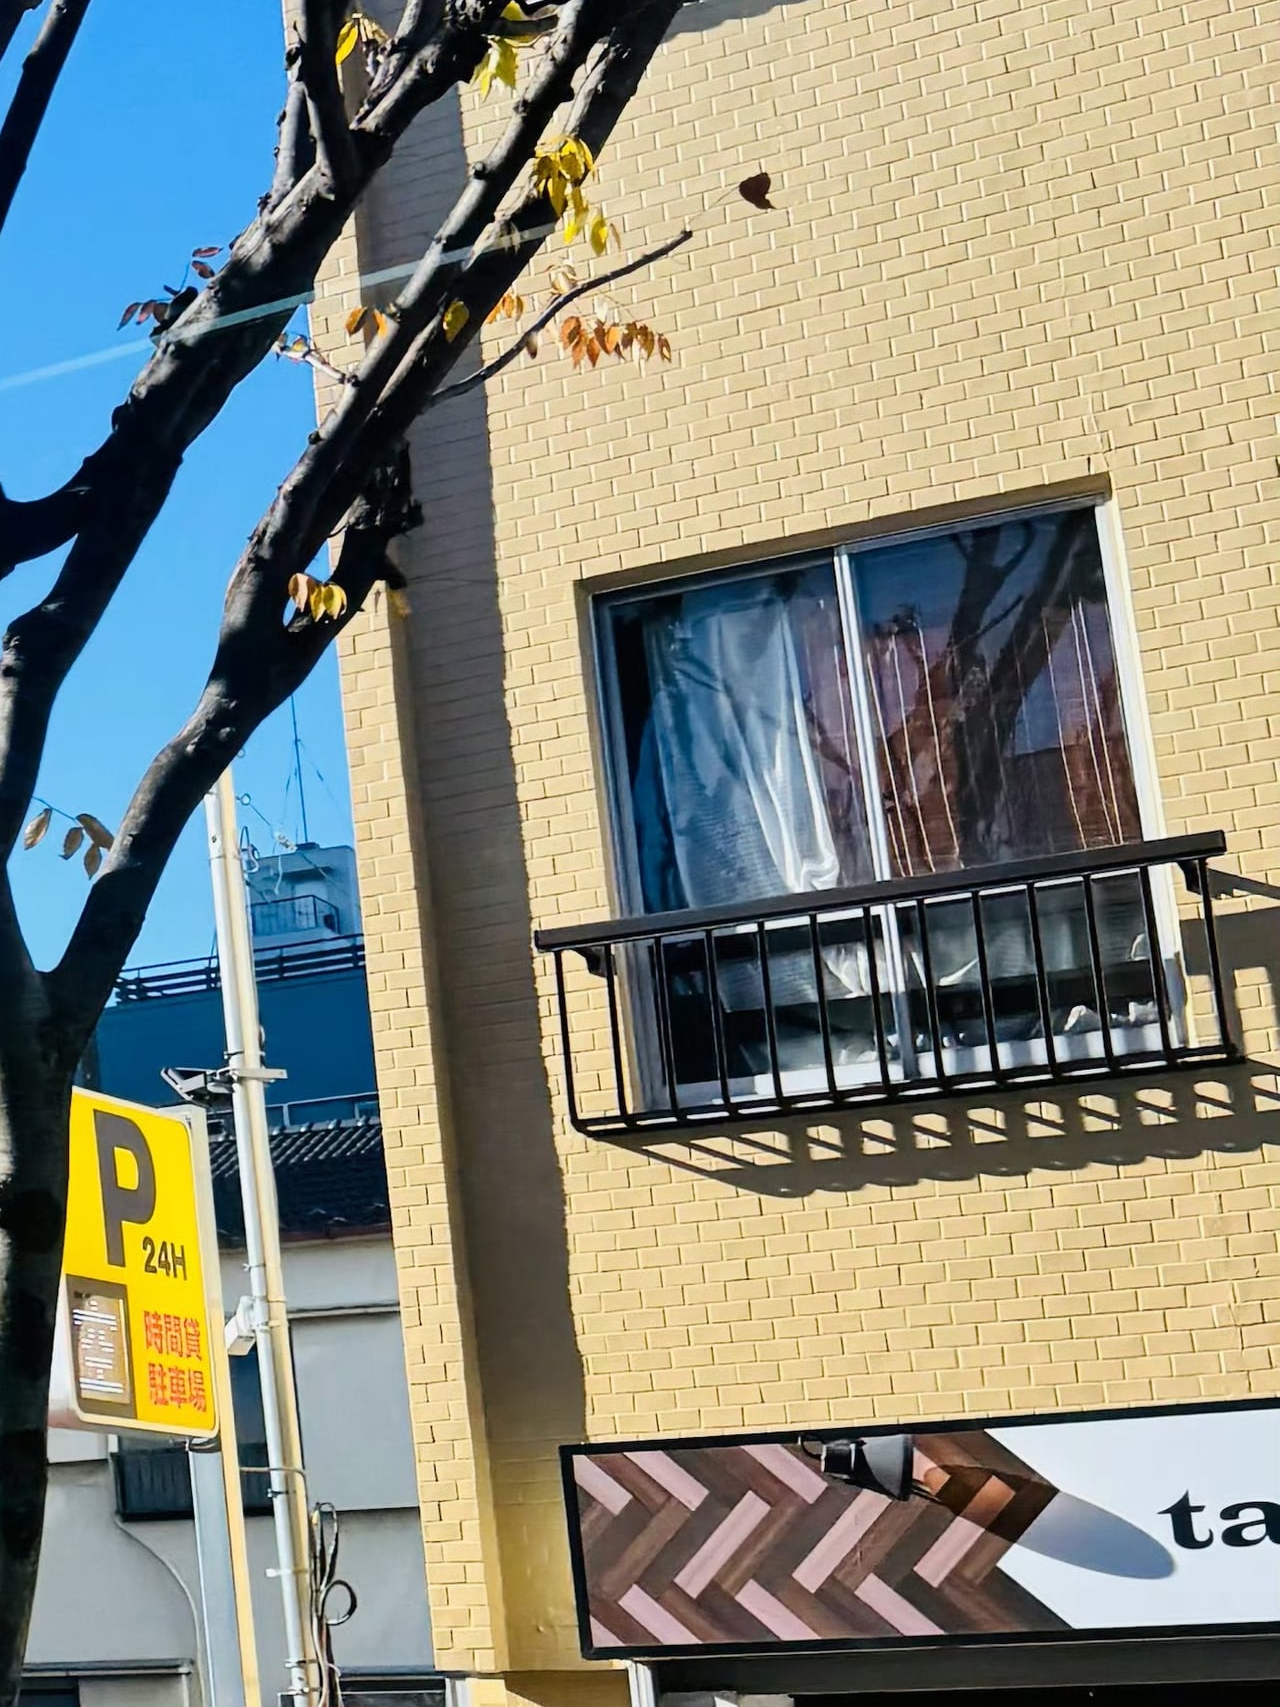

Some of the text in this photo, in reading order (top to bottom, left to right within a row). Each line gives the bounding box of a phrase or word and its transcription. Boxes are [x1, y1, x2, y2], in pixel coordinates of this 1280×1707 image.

[93, 1109, 156, 1267] P
[142, 1236, 187, 1280] 24H
[144, 1310, 203, 1362] 時間貸
[148, 1363, 207, 1413] 駐車場
